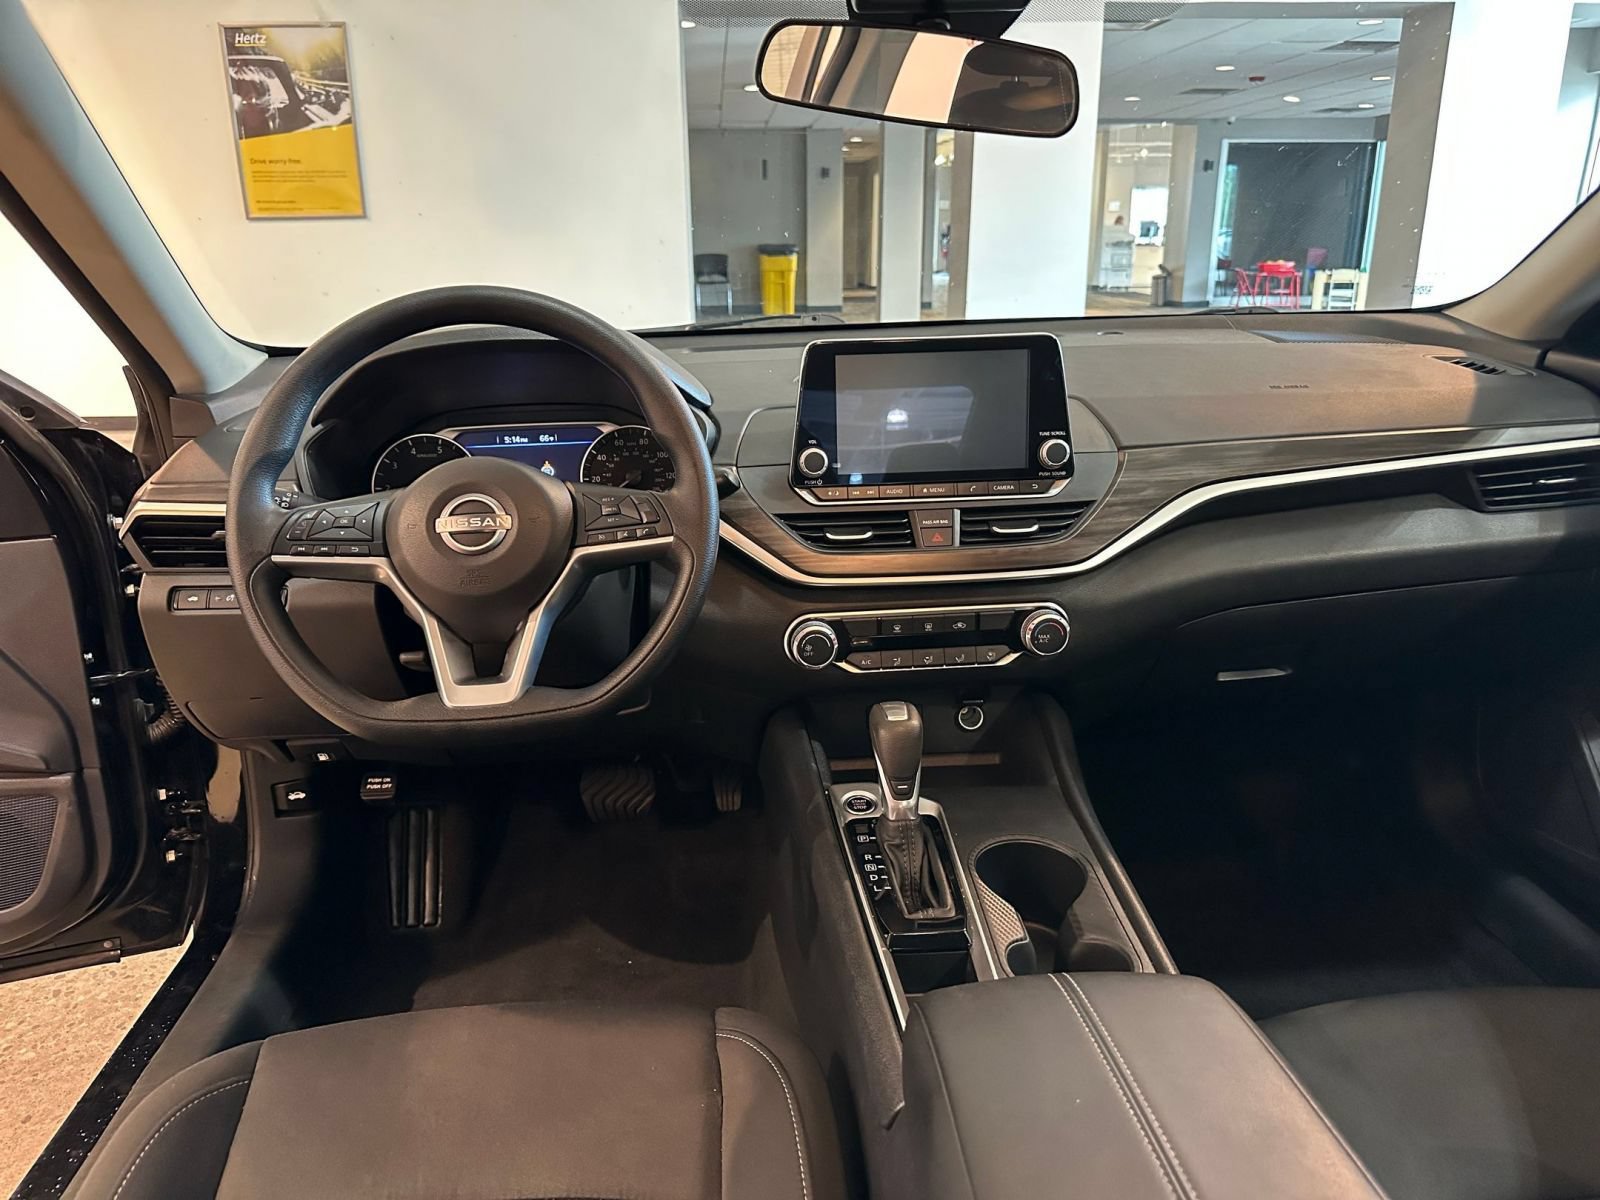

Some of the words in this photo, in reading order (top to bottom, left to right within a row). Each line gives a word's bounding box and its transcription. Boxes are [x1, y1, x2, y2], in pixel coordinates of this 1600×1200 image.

[235, 32, 267, 44] Hertz
[410, 447, 416, 455] 4
[437, 446, 443, 454] 5
[392, 461, 398, 470] 3
[591, 475, 601, 483] 20
[437, 517, 508, 530] NISSAN
